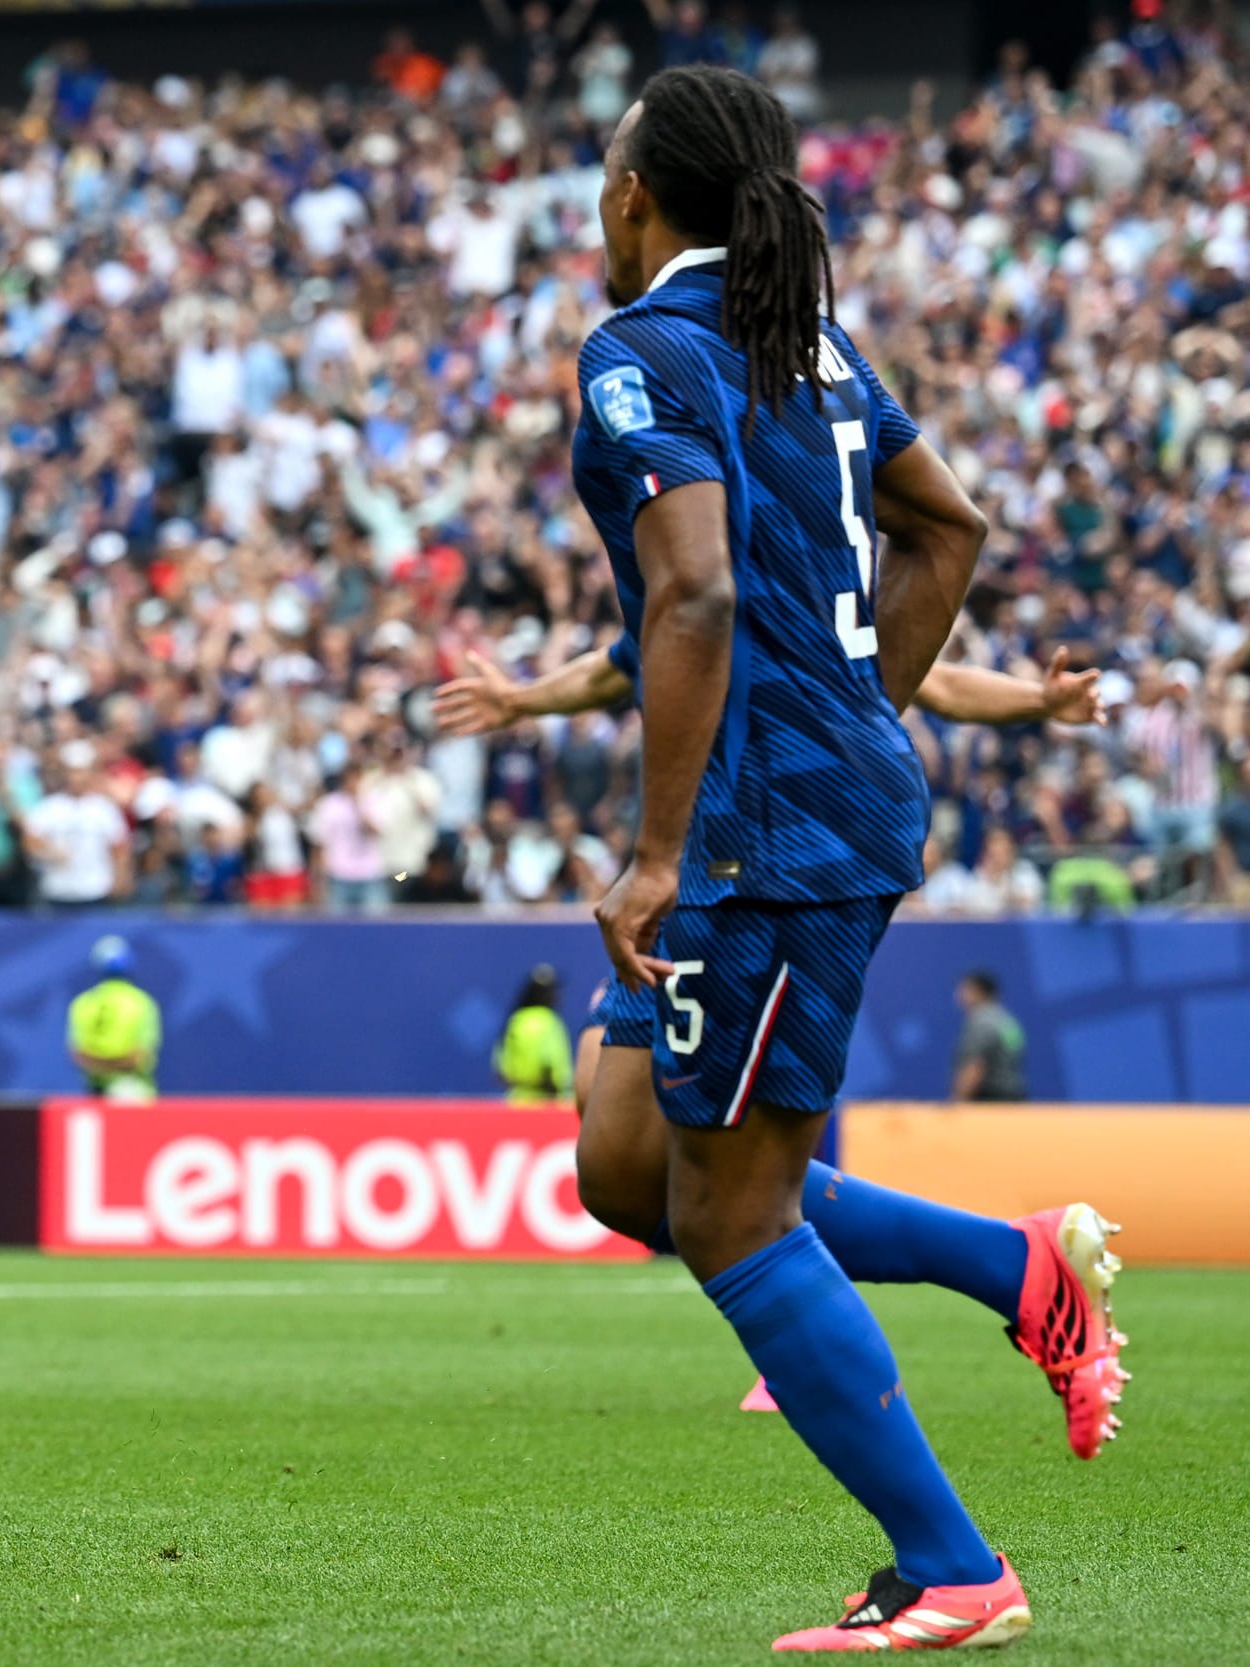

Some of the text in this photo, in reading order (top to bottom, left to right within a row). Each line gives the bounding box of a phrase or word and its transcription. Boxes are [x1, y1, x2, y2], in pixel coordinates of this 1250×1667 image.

[831, 420, 879, 660] 5
[665, 960, 704, 1055] 5
[65, 1109, 611, 1251] Lenovo
